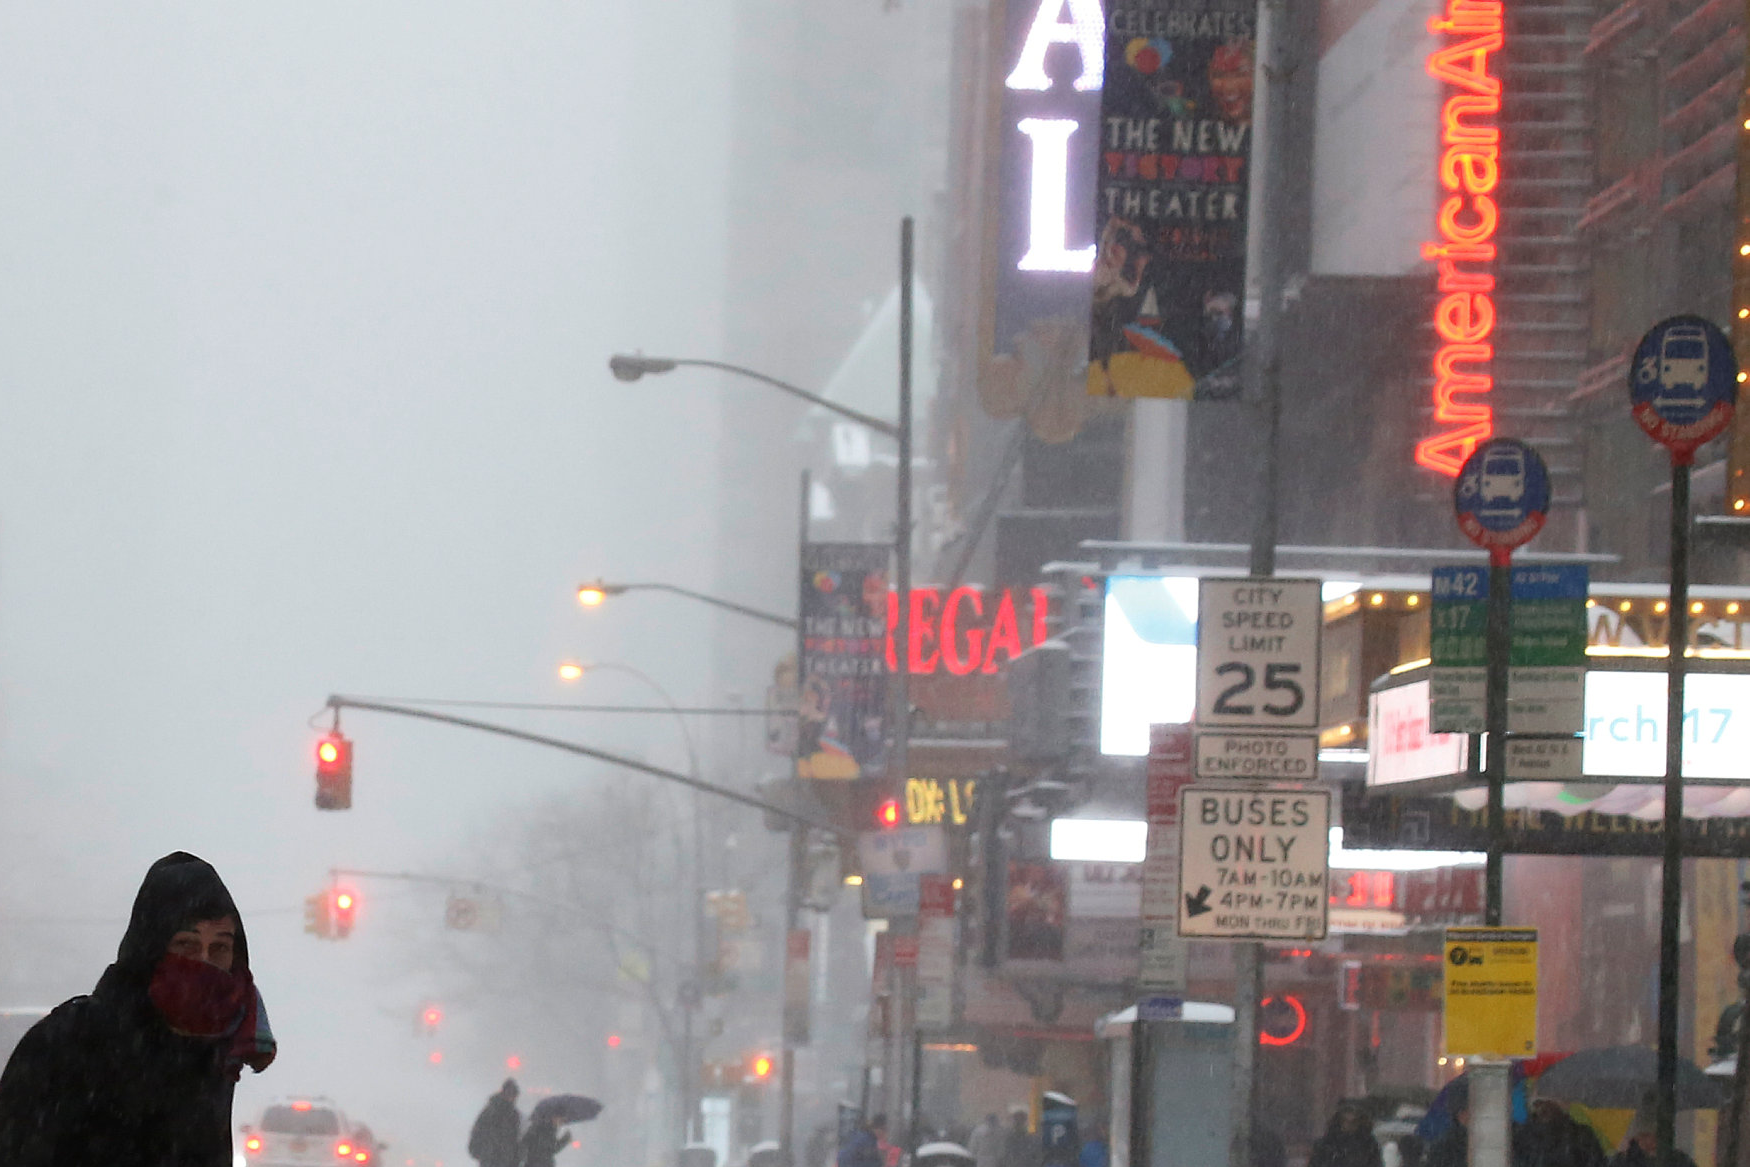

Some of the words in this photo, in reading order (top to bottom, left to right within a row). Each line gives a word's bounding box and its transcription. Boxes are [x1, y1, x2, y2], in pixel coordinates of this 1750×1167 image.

[1106, 117, 1161, 149] THE
[1172, 120, 1249, 151] NEW
[1103, 187, 1240, 220] THEATER
[1232, 587, 1283, 606] CITY
[1222, 611, 1294, 630] SPEED
[1228, 635, 1286, 652] LIMIT
[1212, 661, 1306, 716] 25
[1224, 740, 1289, 758] PHOTO
[1204, 757, 1308, 776] ENFORCED
[1200, 798, 1310, 827] BUSES
[1210, 834, 1298, 864] ONLY
[1216, 868, 1325, 888] 7AM-10AM
[1219, 890, 1319, 912] 4PM-7PM
[1215, 913, 1250, 930] MON
[1254, 915, 1290, 930] THRU
[1295, 914, 1324, 931] FRI
